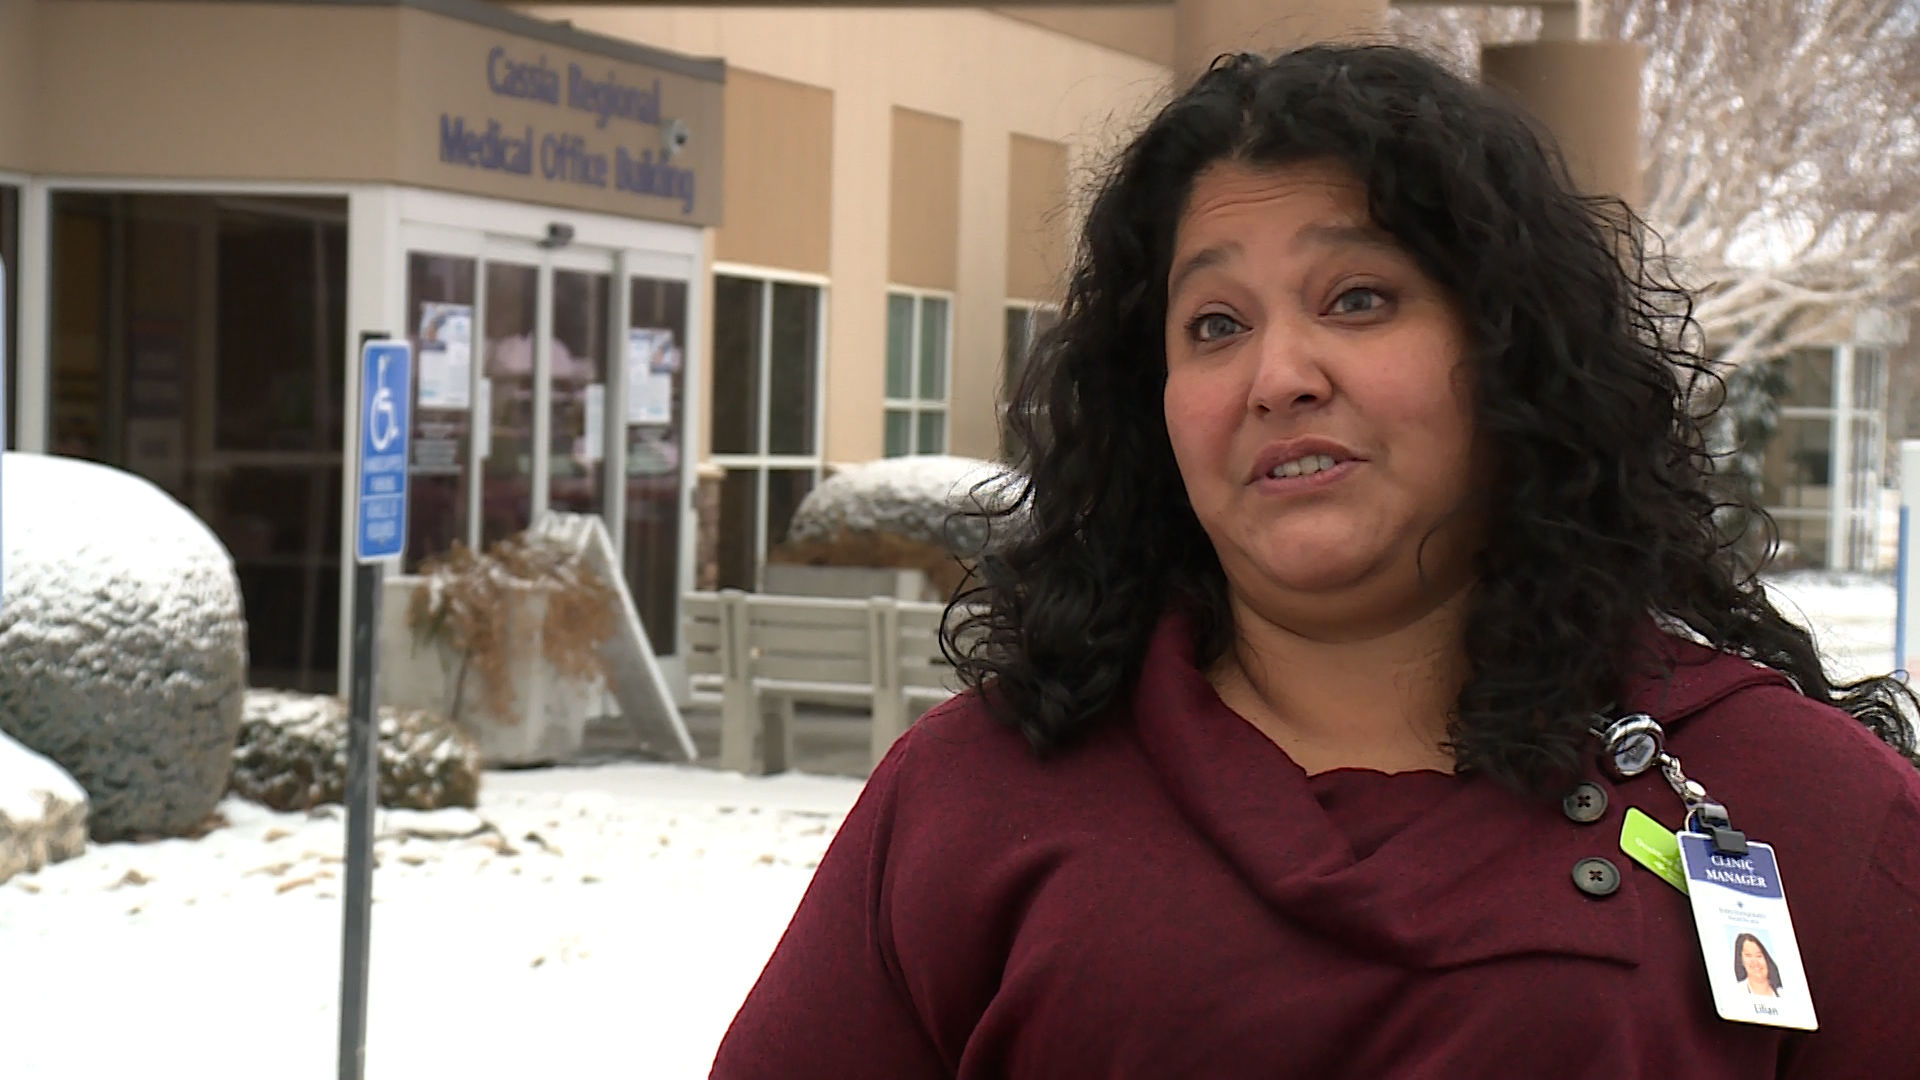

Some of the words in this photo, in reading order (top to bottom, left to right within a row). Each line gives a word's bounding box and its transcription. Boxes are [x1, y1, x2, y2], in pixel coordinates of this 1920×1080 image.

[487, 46, 561, 106] Cassia
[568, 63, 660, 130] Regional
[440, 112, 533, 176] Medical
[541, 132, 608, 188] Office
[615, 146, 694, 214] Building
[1710, 855, 1755, 871] CLINIC
[1705, 869, 1767, 888] MANAGER
[1753, 1003, 1778, 1016] Lilian
